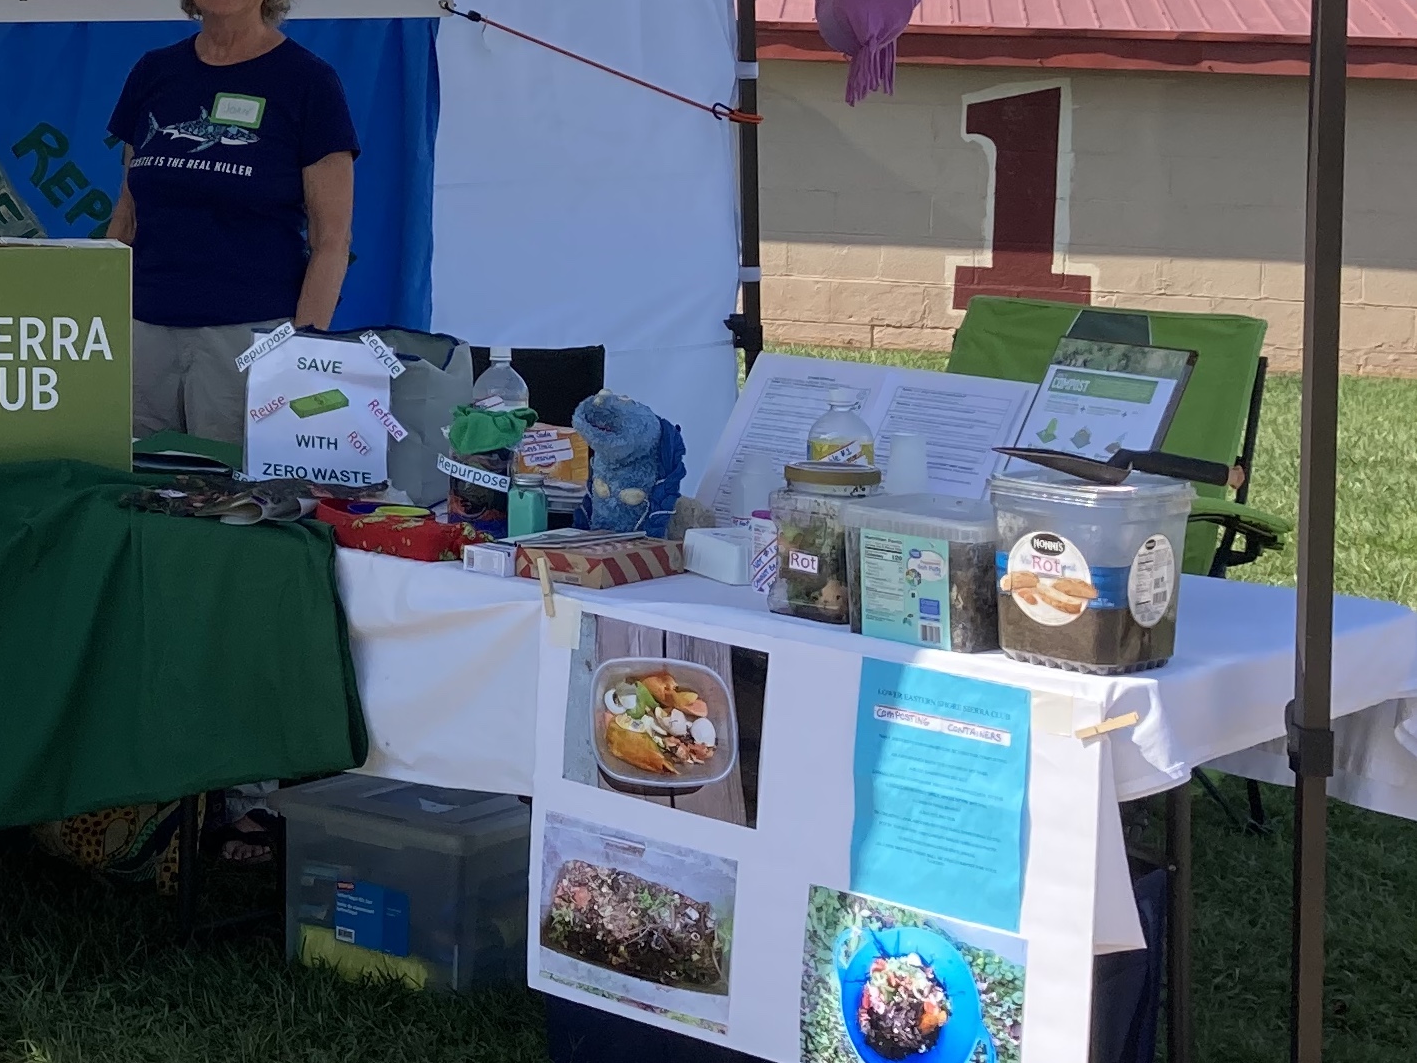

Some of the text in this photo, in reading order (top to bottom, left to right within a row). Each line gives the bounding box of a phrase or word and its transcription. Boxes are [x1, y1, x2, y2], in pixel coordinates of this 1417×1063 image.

[167, 156, 186, 168] THE
[186, 158, 211, 171] REAL
[214, 161, 253, 177] KILLER
[236, 323, 292, 370] Repurpose
[363, 330, 402, 375] Recycle
[296, 356, 343, 374] SAVE
[249, 395, 287, 422] Reuse
[367, 399, 404, 439] Refuse
[295, 434, 338, 451] WITH
[347, 431, 369, 456] Rot
[262, 463, 308, 479] ZERO
[311, 467, 372, 485] WASTE
[438, 456, 508, 490] Repurpose
[790, 553, 818, 571] Rot
[1032, 555, 1061, 574] Rot
